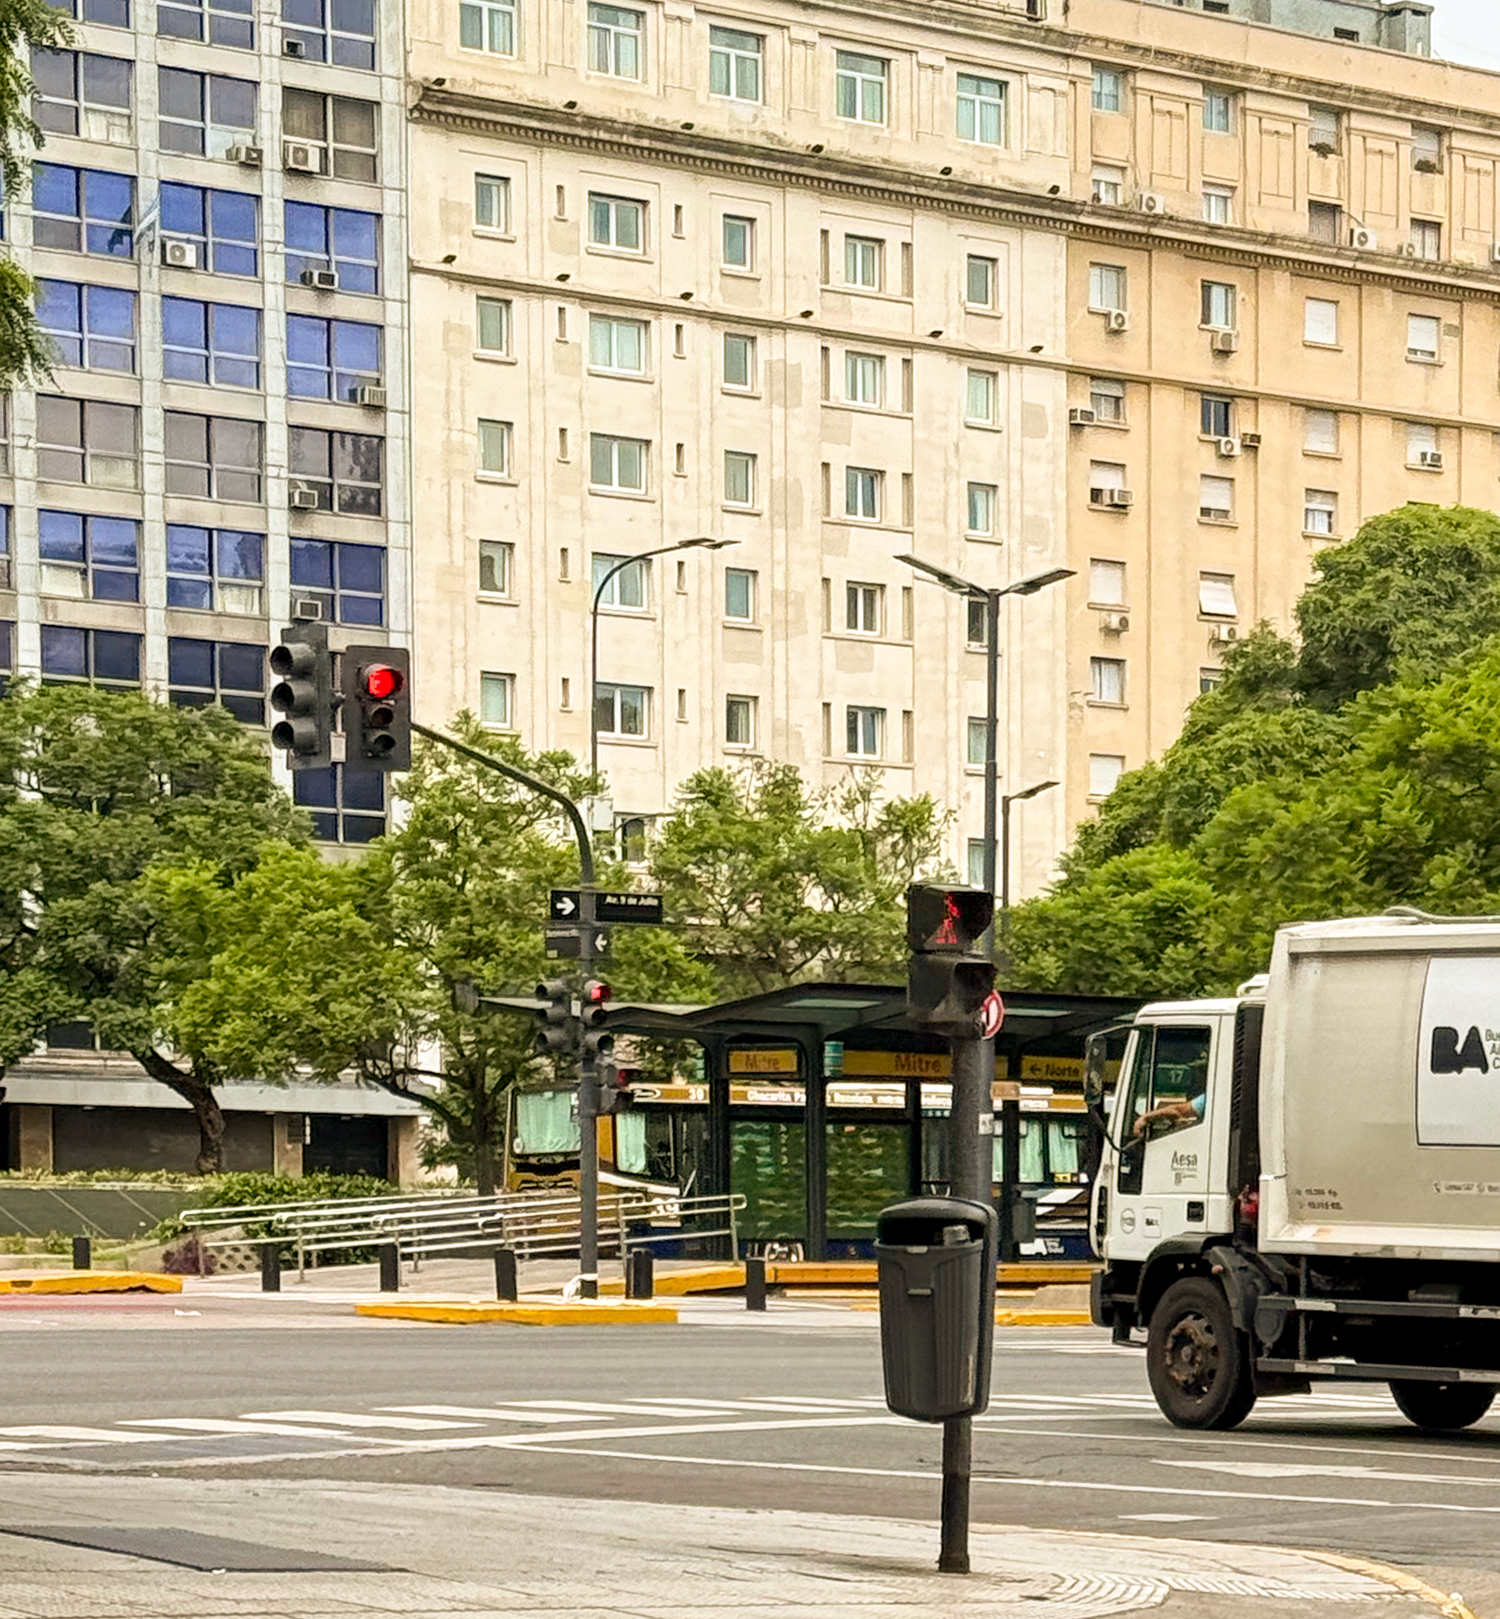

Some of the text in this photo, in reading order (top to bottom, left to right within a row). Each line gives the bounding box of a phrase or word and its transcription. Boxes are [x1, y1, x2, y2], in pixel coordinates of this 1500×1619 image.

[1431, 1026, 1489, 1075] BA
[745, 1053, 780, 1070] Mitre
[894, 1054, 940, 1072] Mitre
[1045, 1063, 1080, 1077] Norte
[1171, 1151, 1198, 1167] Aesa
